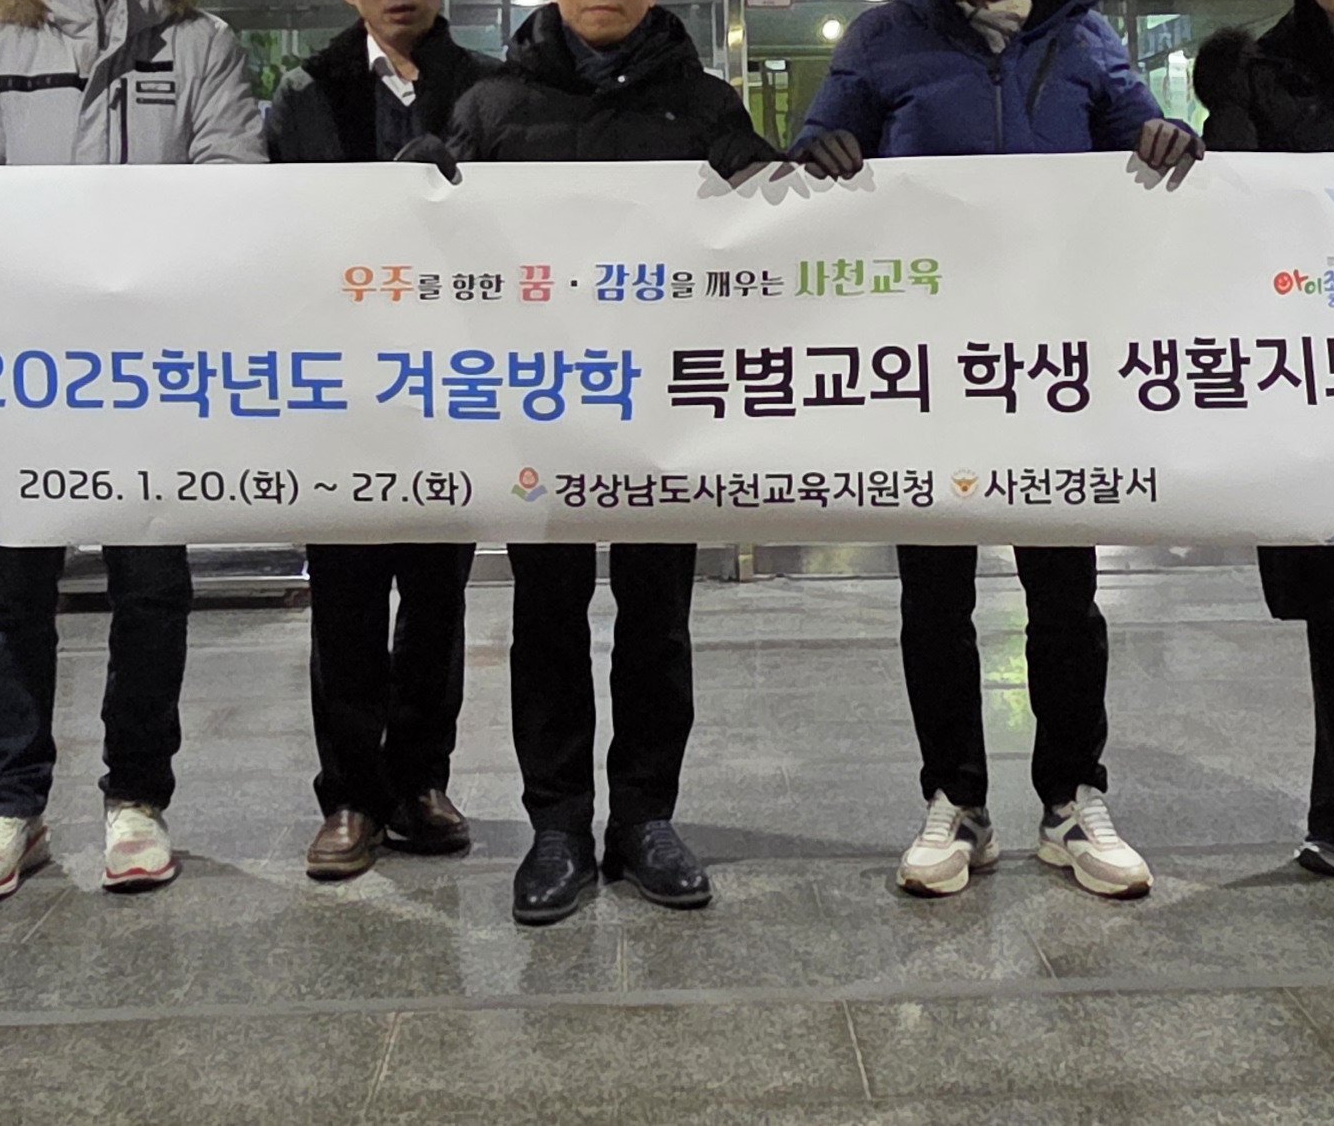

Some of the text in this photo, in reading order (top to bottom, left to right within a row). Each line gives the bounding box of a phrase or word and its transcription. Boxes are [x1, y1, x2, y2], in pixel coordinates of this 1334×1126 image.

[342, 265, 443, 302] 우주를
[451, 272, 506, 302] 향한
[519, 265, 555, 302] 꿈
[595, 263, 696, 302] 감성을
[705, 270, 785, 298] 깨우는
[794, 258, 943, 297] 사천교육
[375, 348, 642, 422] 겨울방학
[666, 343, 931, 419] 특별교외
[956, 340, 1091, 414] 학생
[19, 469, 124, 501] 2026.
[137, 470, 163, 501] 1.
[176, 468, 299, 506] 20.(화)
[352, 469, 473, 507] 27.(화)
[555, 469, 935, 509] 경상남도사천교육지원청
[984, 466, 1158, 506] 사천경찰서
